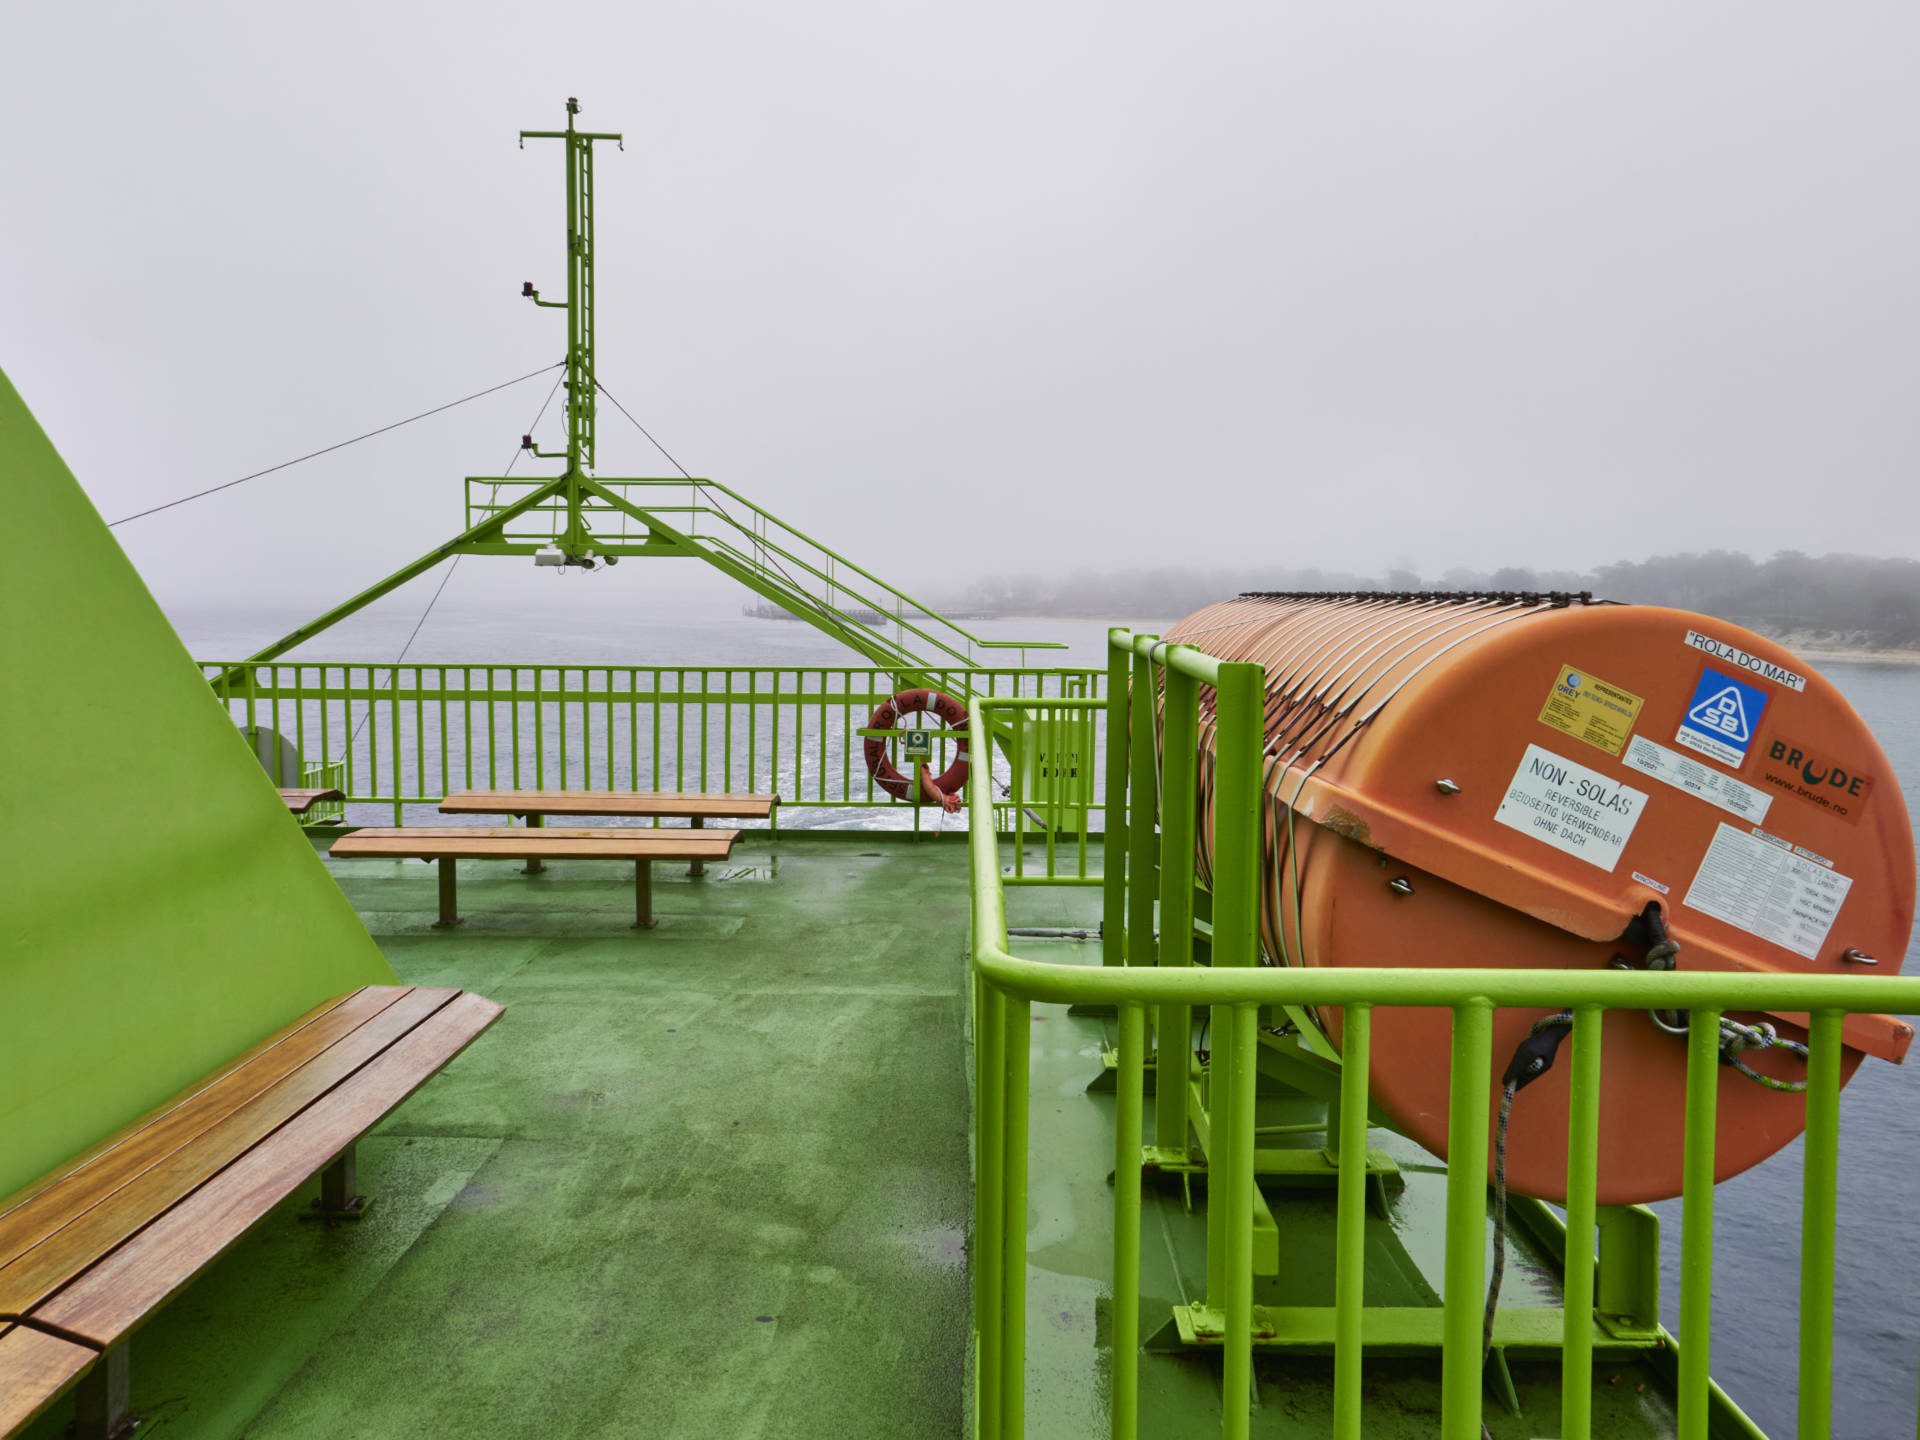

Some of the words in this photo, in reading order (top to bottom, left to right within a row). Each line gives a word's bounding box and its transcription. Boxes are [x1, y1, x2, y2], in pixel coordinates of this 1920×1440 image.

[1689, 631, 1734, 662] "ROLA
[1738, 652, 1762, 672] DO
[1763, 663, 1804, 687] MAR"
[1557, 684, 1582, 699] OREY
[1529, 757, 1568, 786] NON
[1576, 779, 1633, 816] SOLAS
[1768, 740, 1864, 797] BRUDE
[1509, 788, 1558, 819] BEIDSEITIG
[1561, 811, 1623, 847] VERWENDBAR
[1544, 788, 1601, 821] REVERSIBLE
[1764, 772, 1848, 815] www.brude.no
[1533, 816, 1559, 835] OHNE
[1560, 827, 1587, 847] DACH
